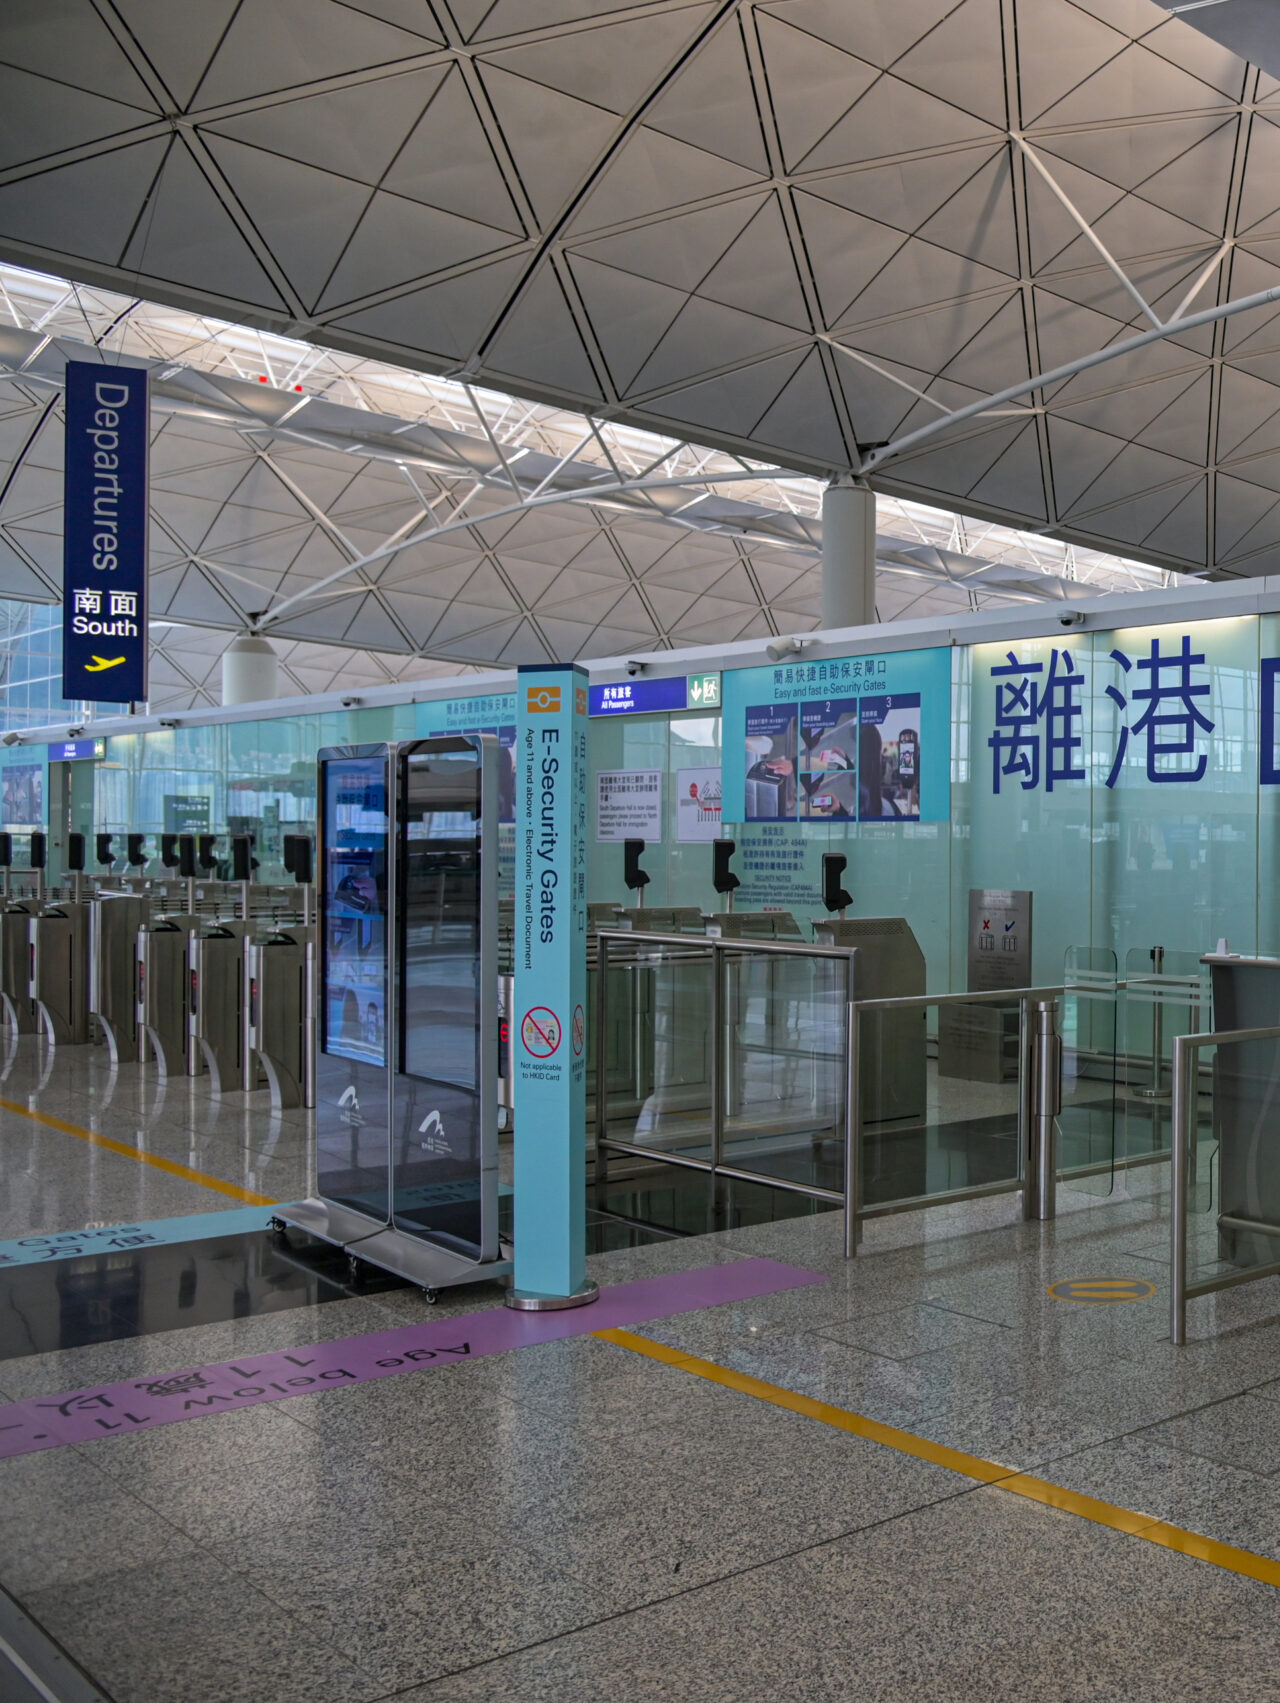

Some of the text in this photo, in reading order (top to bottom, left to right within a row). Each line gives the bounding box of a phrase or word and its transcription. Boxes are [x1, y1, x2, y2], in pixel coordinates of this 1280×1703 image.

[86, 382, 129, 571] Departures
[72, 588, 138, 617] 南面
[72, 616, 138, 638] South
[773, 660, 887, 685] 簡易快捷自助保安閘口
[603, 686, 632, 700] 所有旅客
[774, 679, 886, 700] Easy and fast e-Security Gates
[608, 700, 634, 709] Passengers
[769, 706, 774, 717] 1
[825, 702, 831, 713] 2
[886, 697, 892, 708] 3
[987, 635, 1215, 795] 離港
[537, 728, 560, 944] E-Security Gates
[524, 728, 535, 970] Age 11 and above Electronic Travel Document
[520, 1061, 531, 1070] Not
[532, 1062, 562, 1072] applicable
[545, 1073, 560, 1081] Card
[18, 1226, 142, 1247] Gates
[95, 1342, 471, 1430] Age below 11
